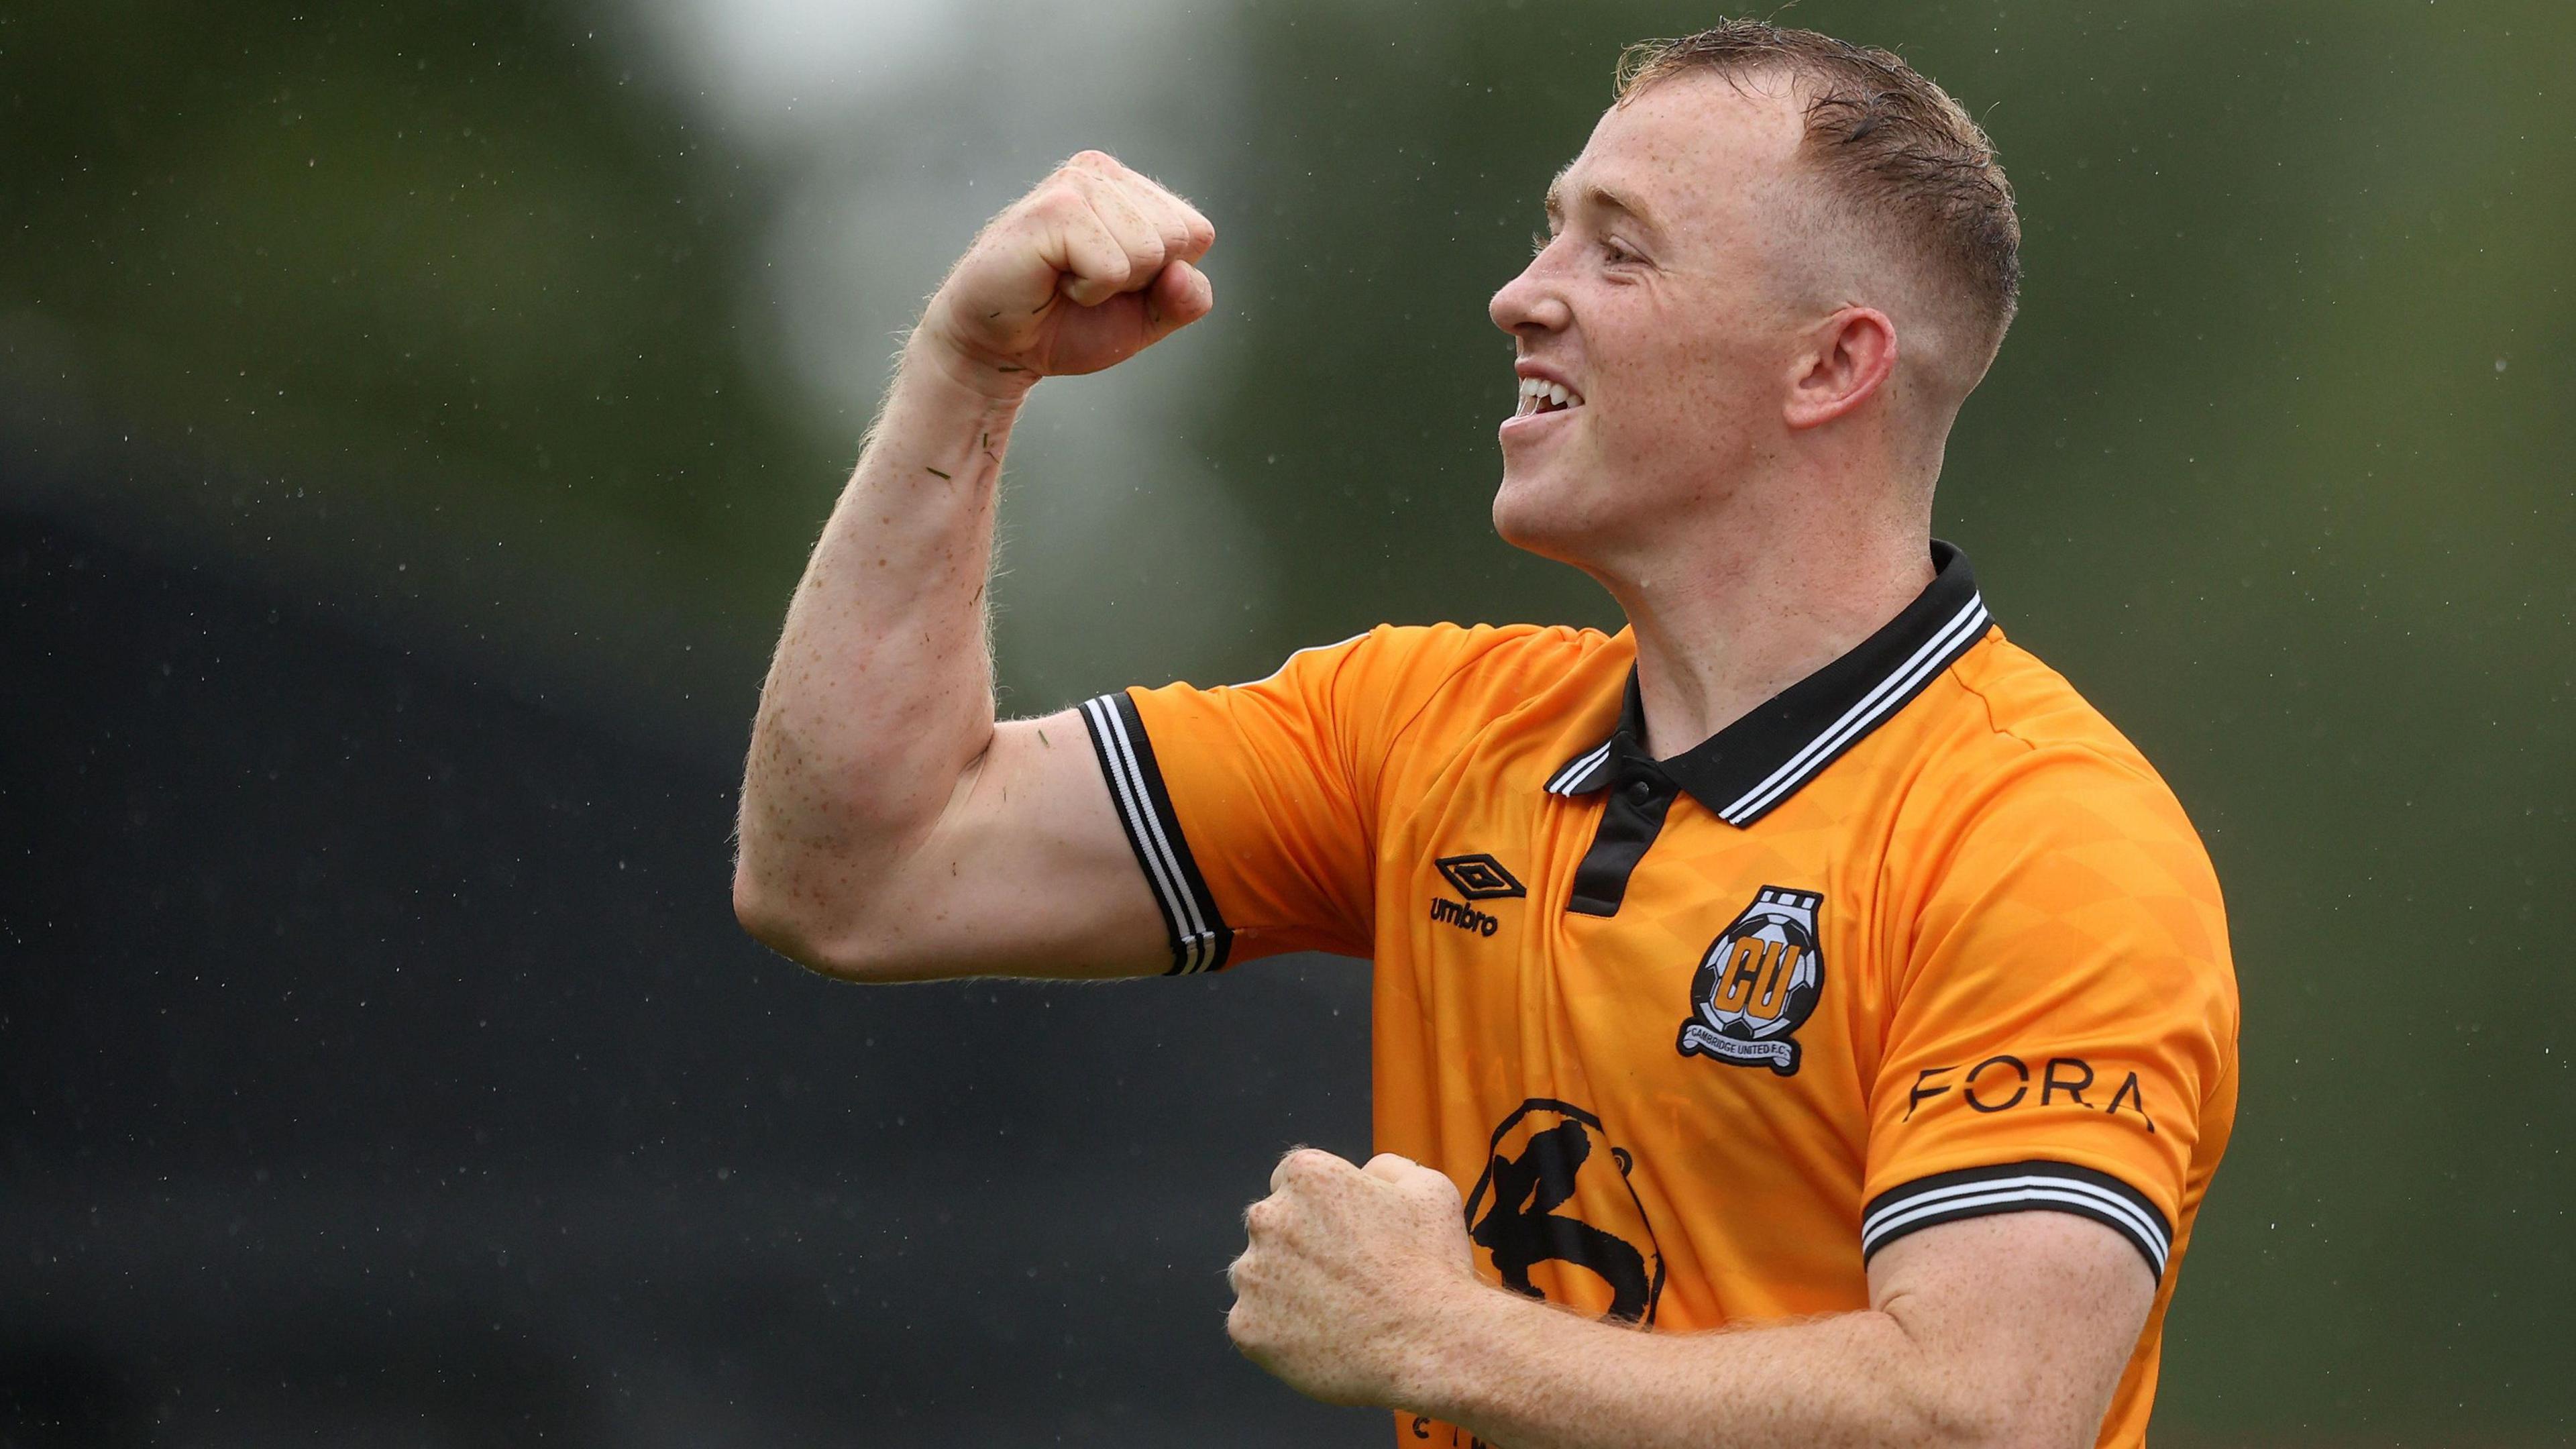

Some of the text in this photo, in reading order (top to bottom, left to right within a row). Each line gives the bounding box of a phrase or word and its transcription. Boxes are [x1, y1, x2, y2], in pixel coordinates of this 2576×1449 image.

[1431, 897, 1498, 937] umbro
[1714, 936, 1801, 1020] CU
[1691, 1028, 1735, 1053] CAMBRIDGE
[1737, 1044, 1770, 1055] UNITED
[1902, 1055, 2155, 1134] FORA
